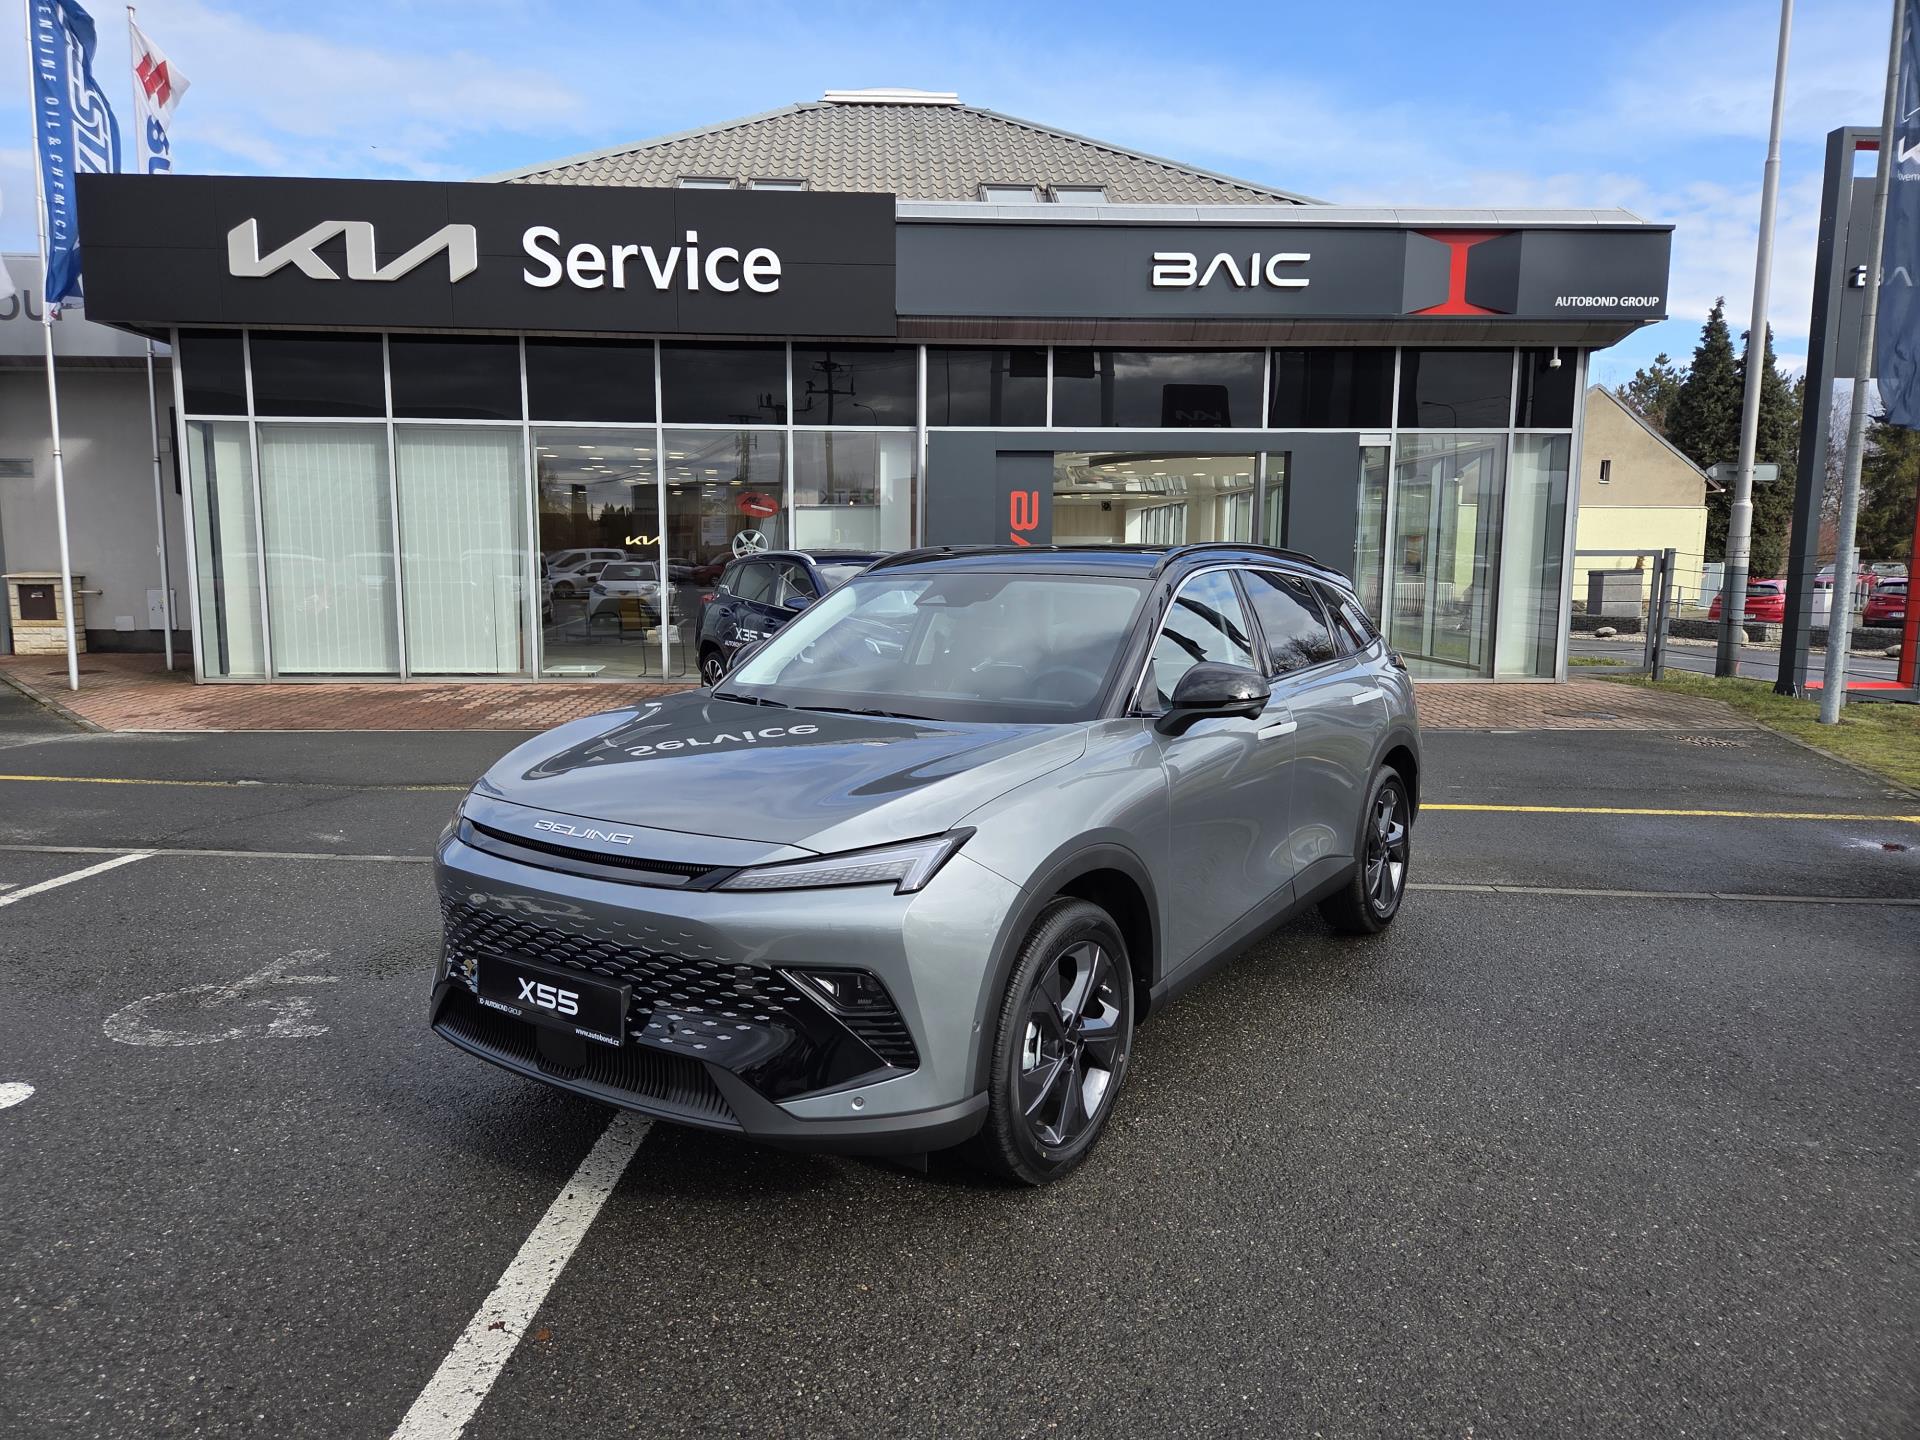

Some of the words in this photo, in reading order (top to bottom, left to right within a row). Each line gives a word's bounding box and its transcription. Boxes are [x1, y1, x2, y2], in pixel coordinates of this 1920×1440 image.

[38, 3, 57, 82] ENUINE
[45, 96, 61, 129] OIL
[227, 217, 478, 284] KIA
[522, 226, 782, 294] Service
[1152, 252, 1311, 287] BAIC
[1555, 296, 1619, 307] AUTOBOND
[1620, 296, 1660, 307] GROUP
[625, 535, 661, 545] KIA
[735, 626, 758, 641] X35
[533, 820, 635, 845] BEIJING
[518, 977, 579, 1016] X55
[575, 1028, 620, 1047] www.autobond.cz
